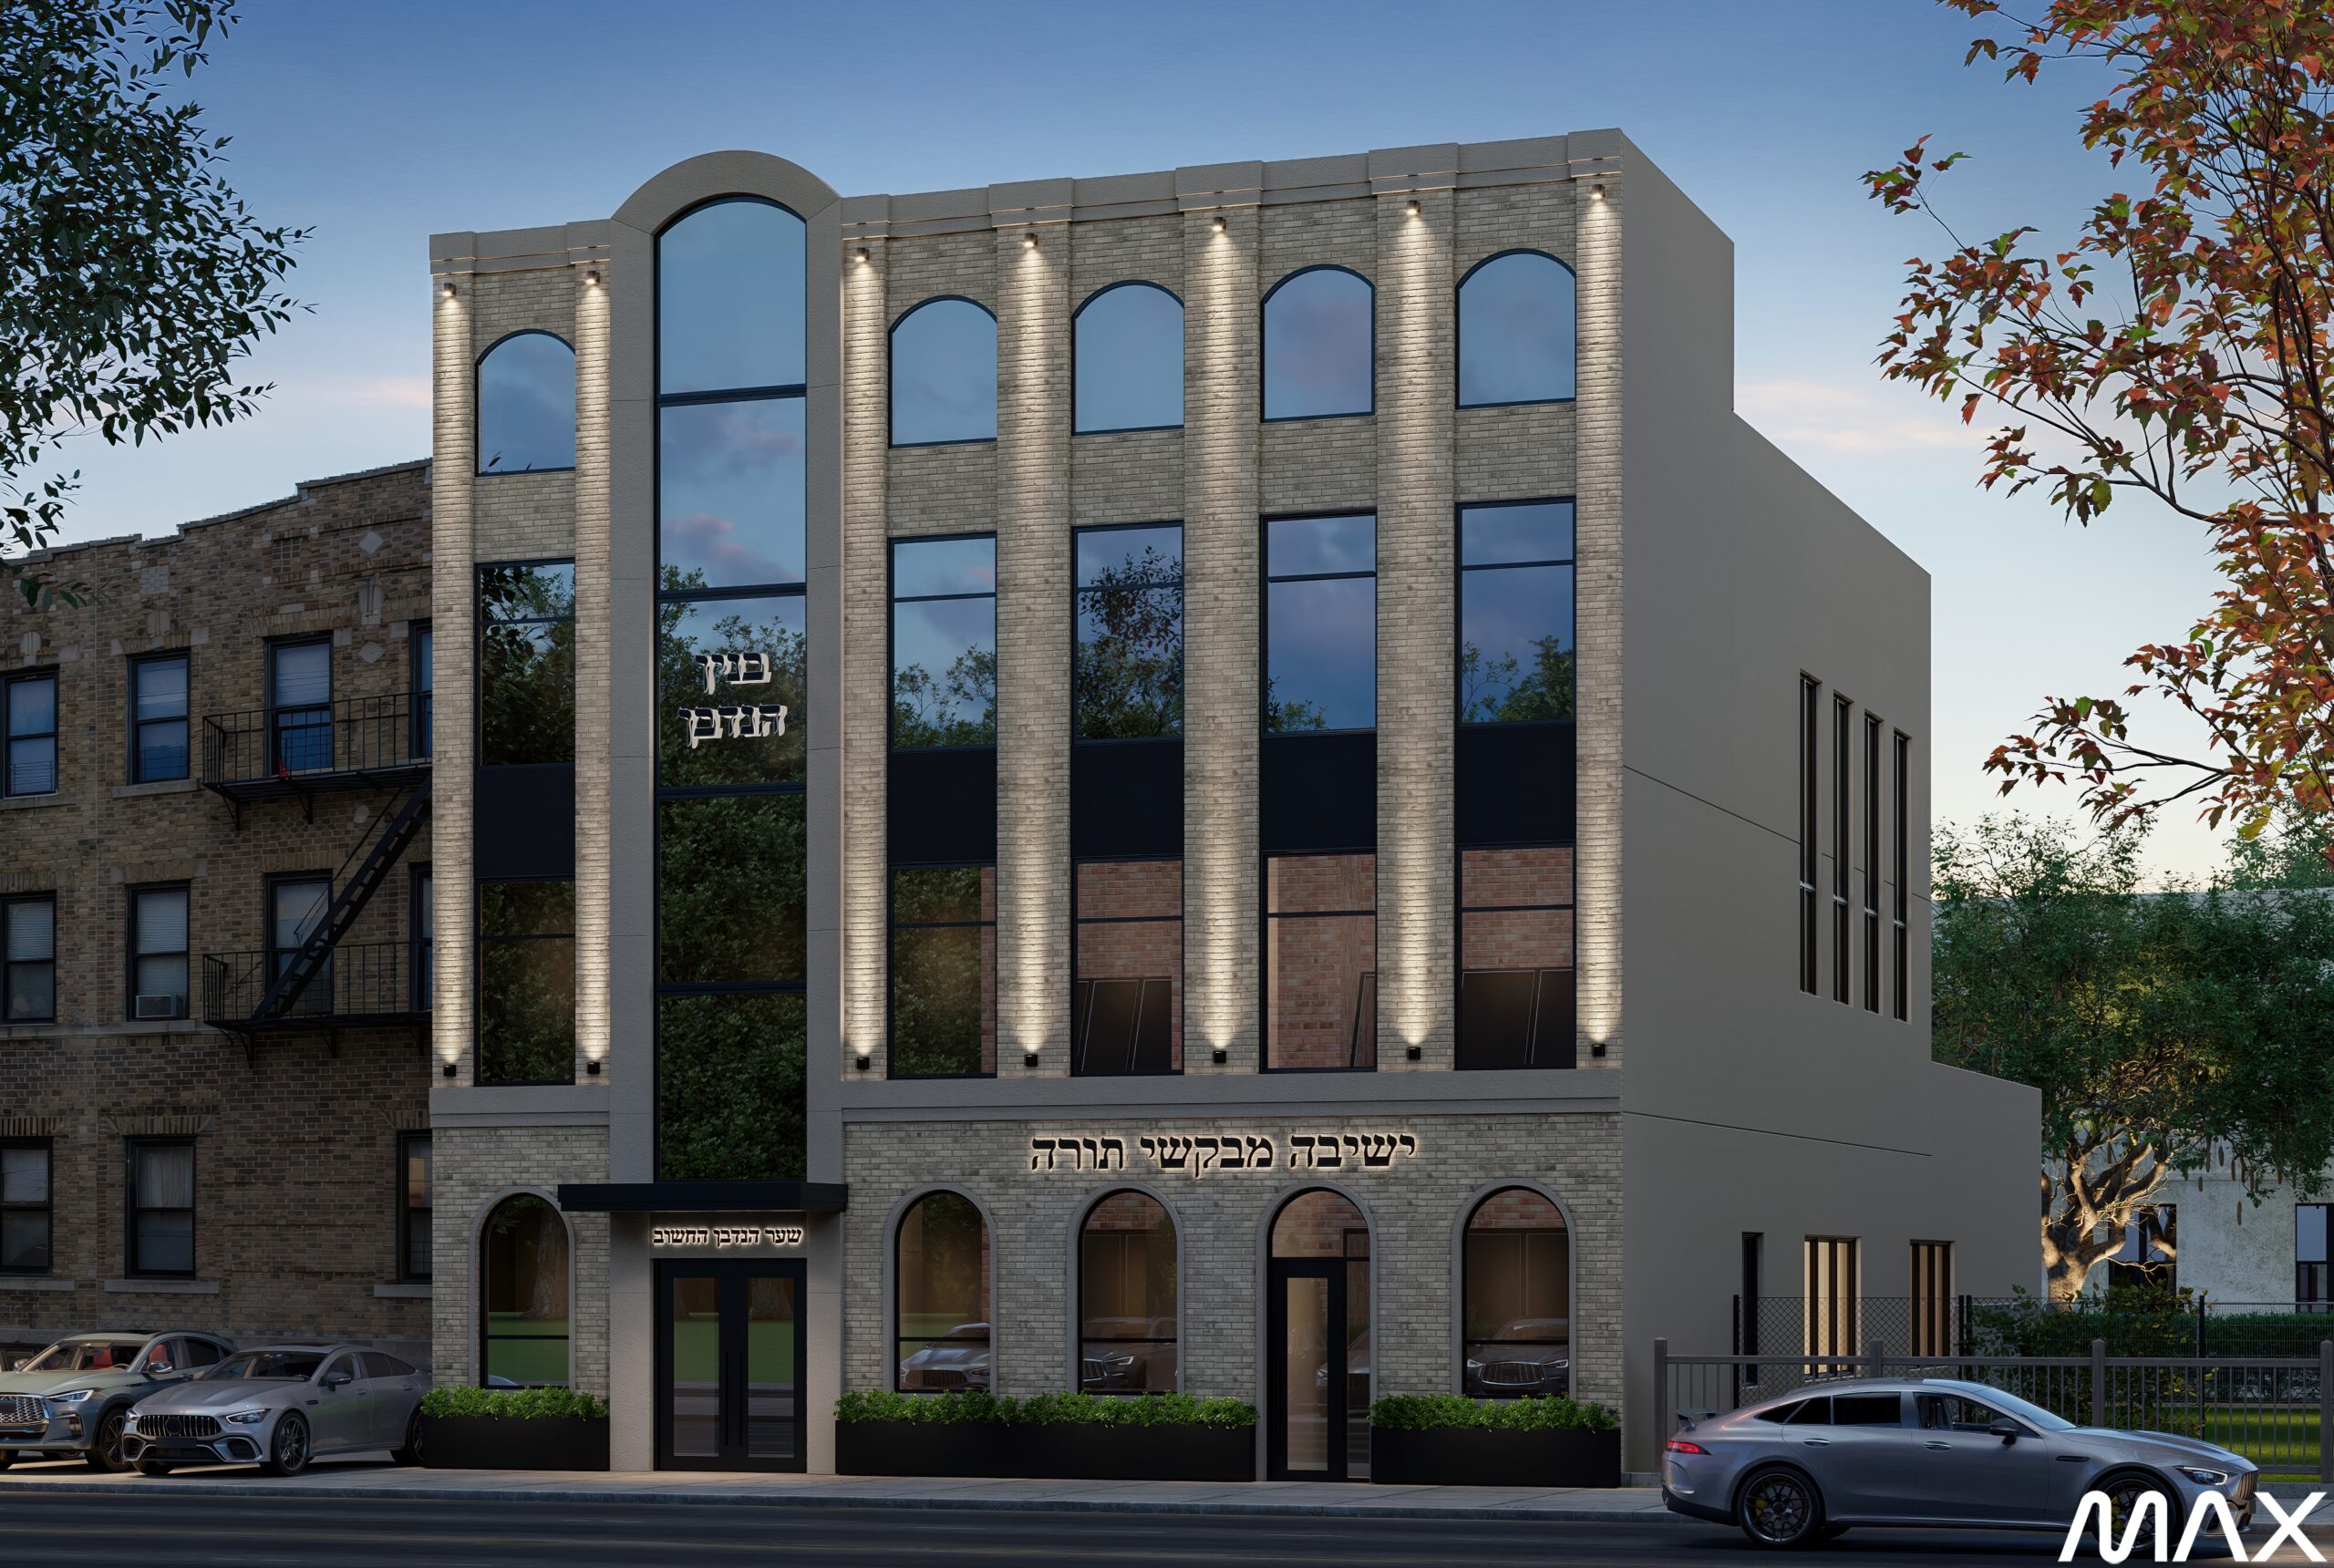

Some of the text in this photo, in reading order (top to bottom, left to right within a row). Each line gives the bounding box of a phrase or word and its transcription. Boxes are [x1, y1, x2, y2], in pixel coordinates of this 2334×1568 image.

[1031, 1134, 1416, 1178] ישיבה מבקשי תורה
[653, 1229, 802, 1247] שער הנדבן החשוב
